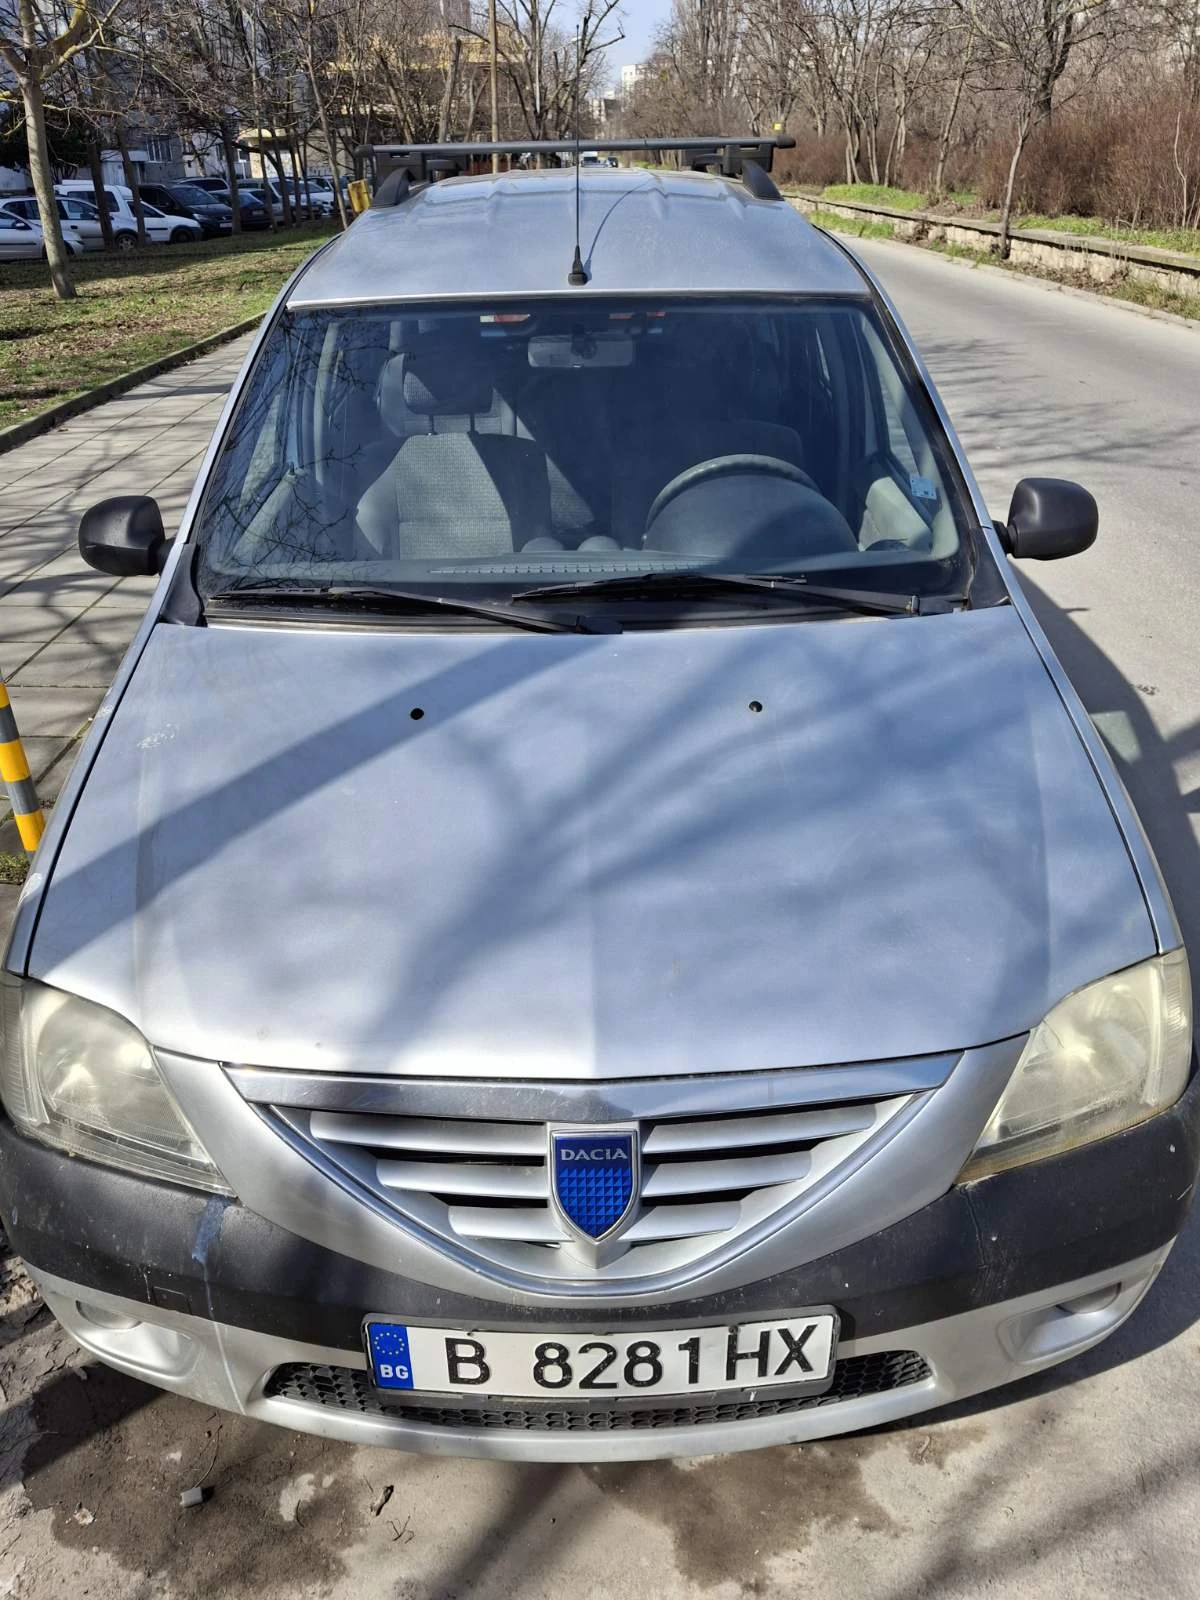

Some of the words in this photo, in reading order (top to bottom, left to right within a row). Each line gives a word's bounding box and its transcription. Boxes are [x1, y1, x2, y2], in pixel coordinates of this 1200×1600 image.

[560, 1148, 628, 1161] DACIA
[445, 1337, 491, 1386] B
[532, 1336, 701, 1390] 8281
[725, 1323, 818, 1381] HX
[379, 1364, 410, 1380] BG
